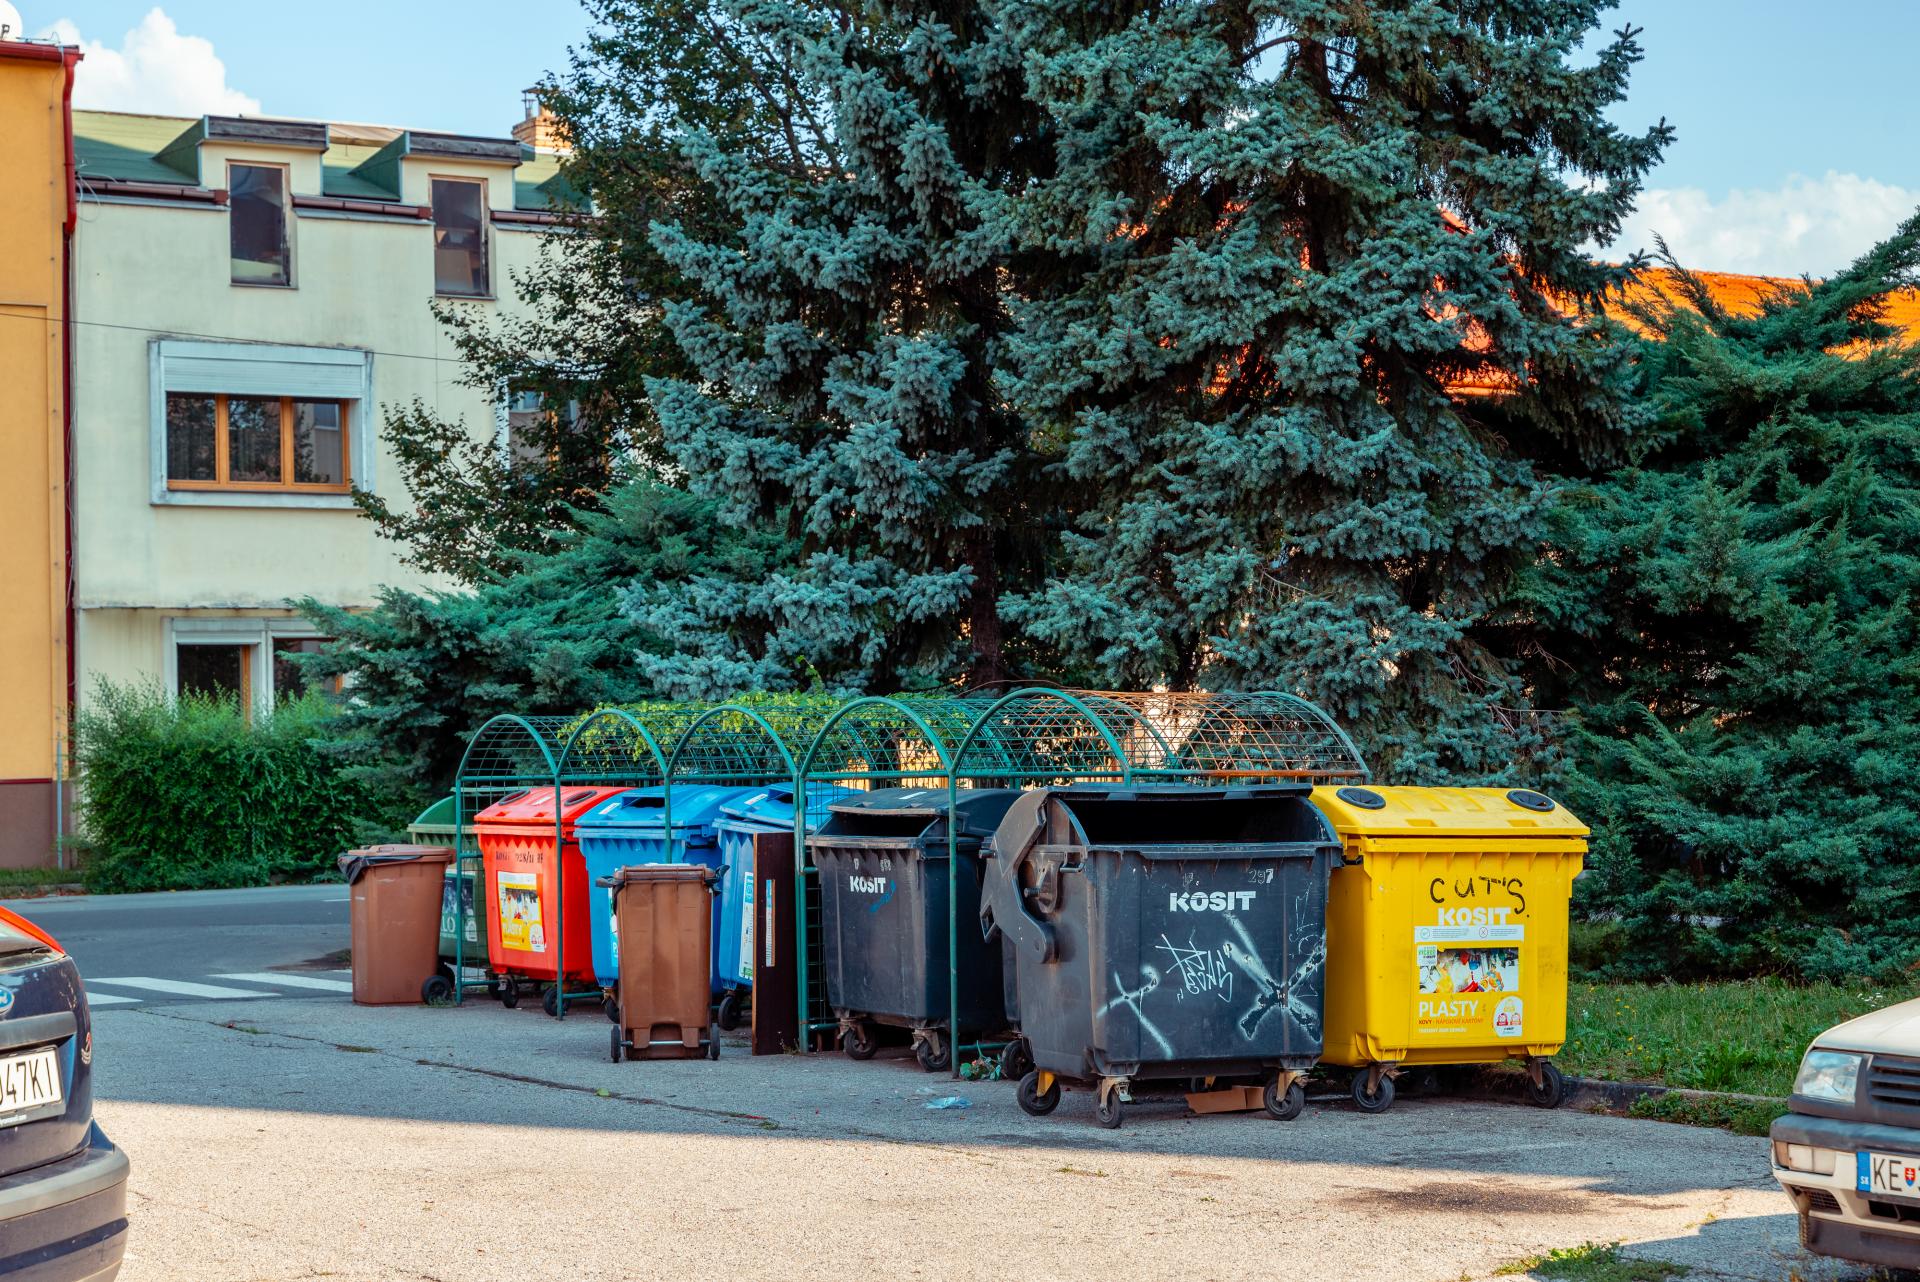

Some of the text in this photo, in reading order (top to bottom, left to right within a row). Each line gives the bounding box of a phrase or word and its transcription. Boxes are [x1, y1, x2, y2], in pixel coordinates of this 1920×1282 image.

[849, 875, 886, 894] KOSIT
[1248, 868, 1274, 885] 297
[1169, 890, 1257, 912] KOSIT
[1437, 907, 1511, 926] KOSIT
[1419, 1000, 1478, 1018] PLASTY
[0, 1057, 53, 1106] 47KI
[1873, 1157, 1902, 1192] KE
